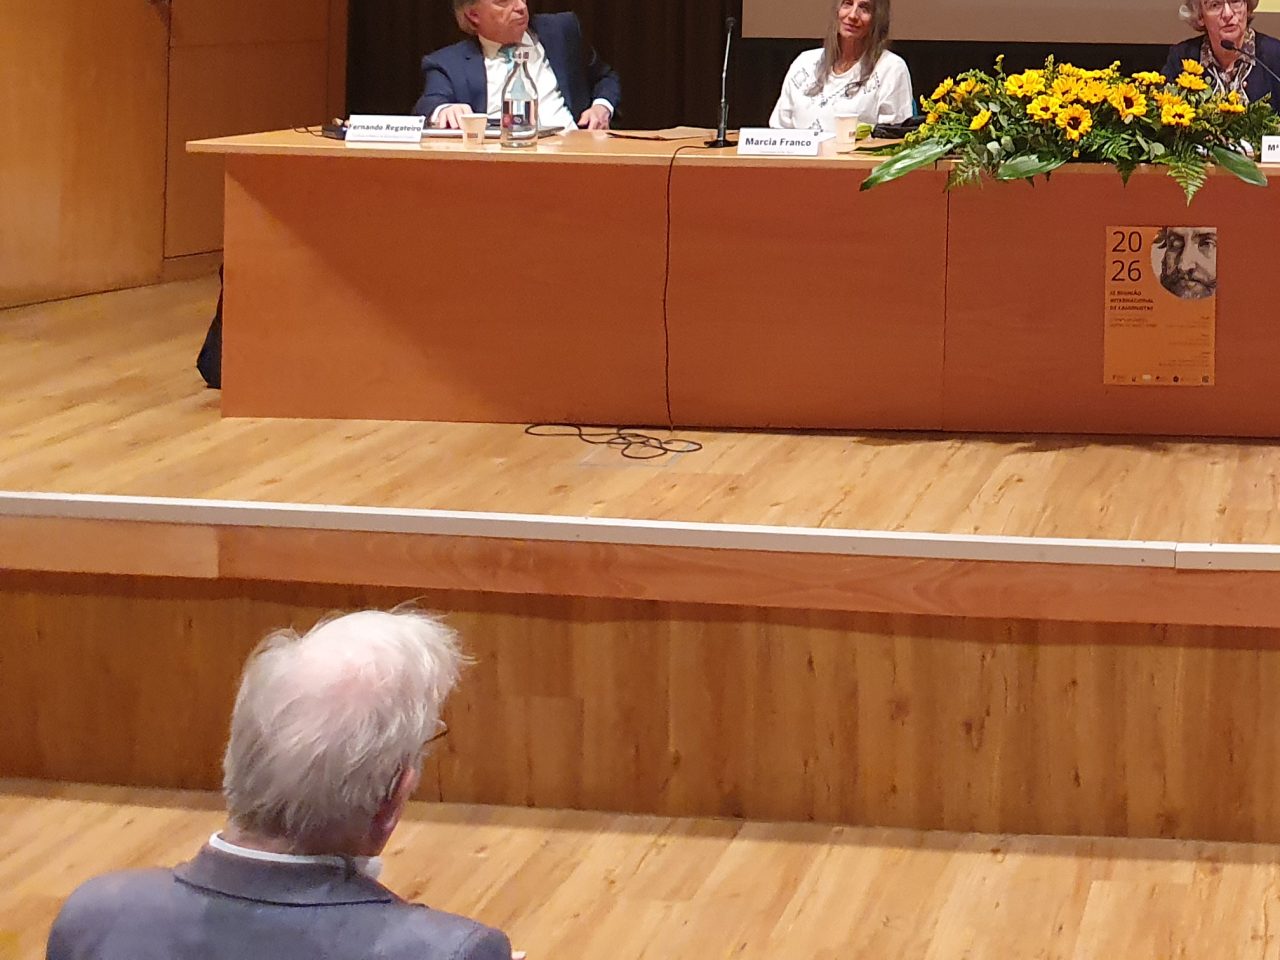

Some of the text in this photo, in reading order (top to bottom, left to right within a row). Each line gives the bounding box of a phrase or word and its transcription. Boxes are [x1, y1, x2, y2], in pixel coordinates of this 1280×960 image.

[779, 138, 812, 148] Franco
[1111, 230, 1142, 253] 20
[1111, 259, 1142, 282] 26
